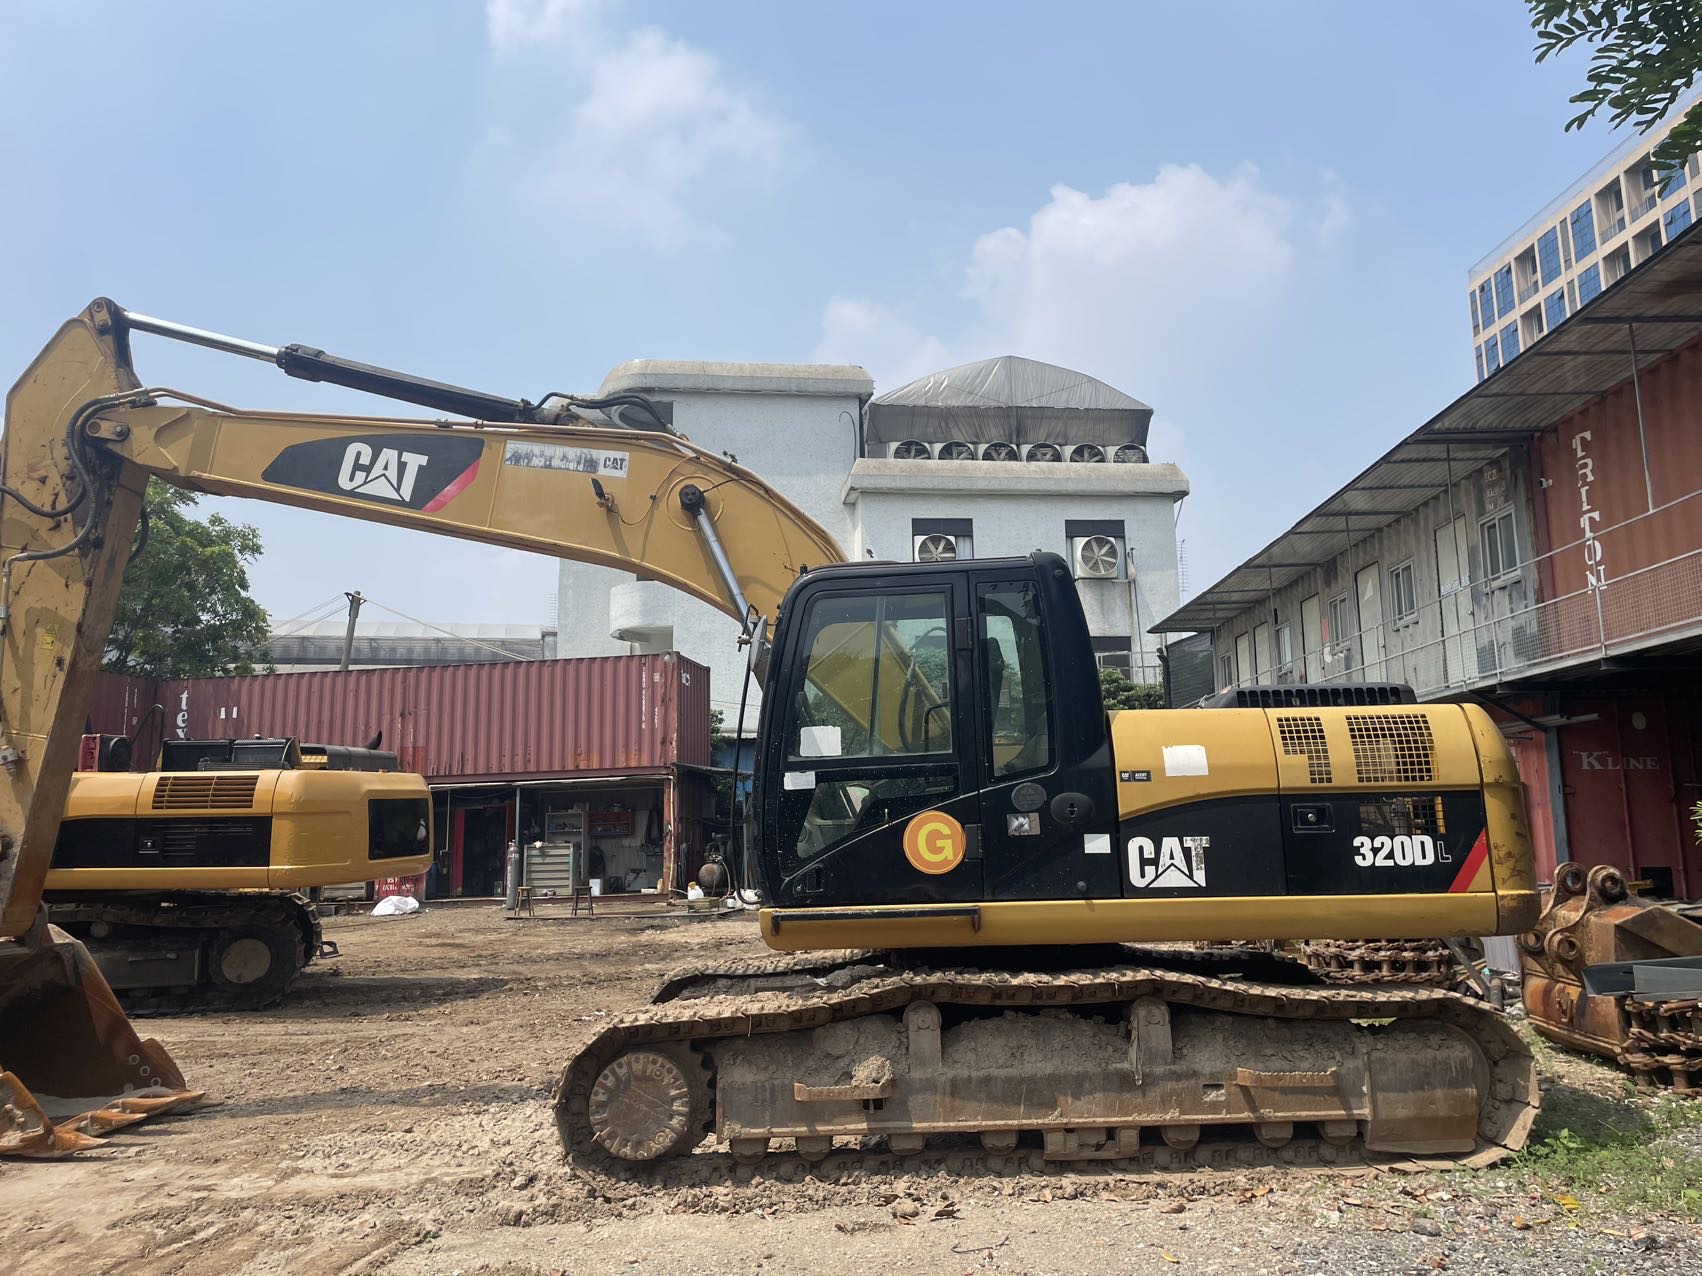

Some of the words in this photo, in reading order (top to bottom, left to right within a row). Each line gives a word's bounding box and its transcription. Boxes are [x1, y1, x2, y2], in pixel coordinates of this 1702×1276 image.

[338, 442, 429, 502] CAT
[603, 456, 626, 470] CAT
[1572, 430, 1607, 594] TRITON
[917, 822, 954, 862] G
[1127, 836, 1210, 888] CAT
